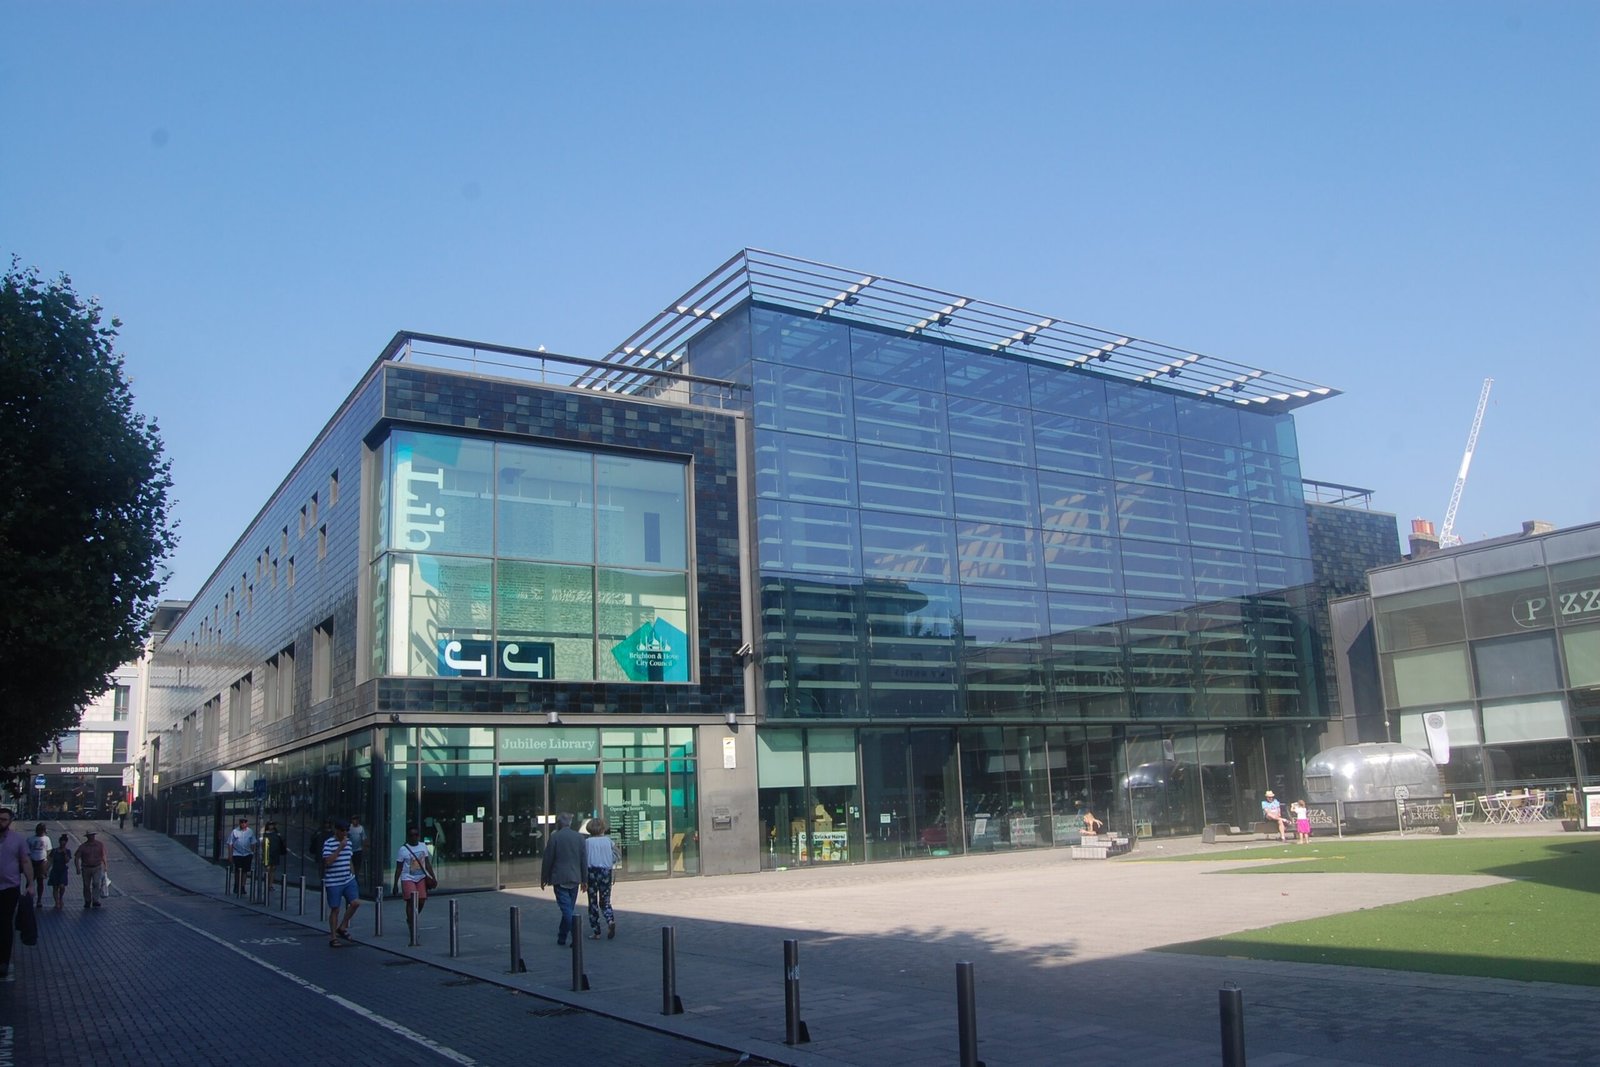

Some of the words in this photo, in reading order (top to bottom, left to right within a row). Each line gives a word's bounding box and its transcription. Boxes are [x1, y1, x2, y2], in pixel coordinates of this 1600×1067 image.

[1526, 588, 1600, 621] PZZ
[629, 652, 656, 660] Brighton
[636, 659, 648, 667] City
[502, 738, 547, 749] Jubilee
[549, 738, 595, 751] Library
